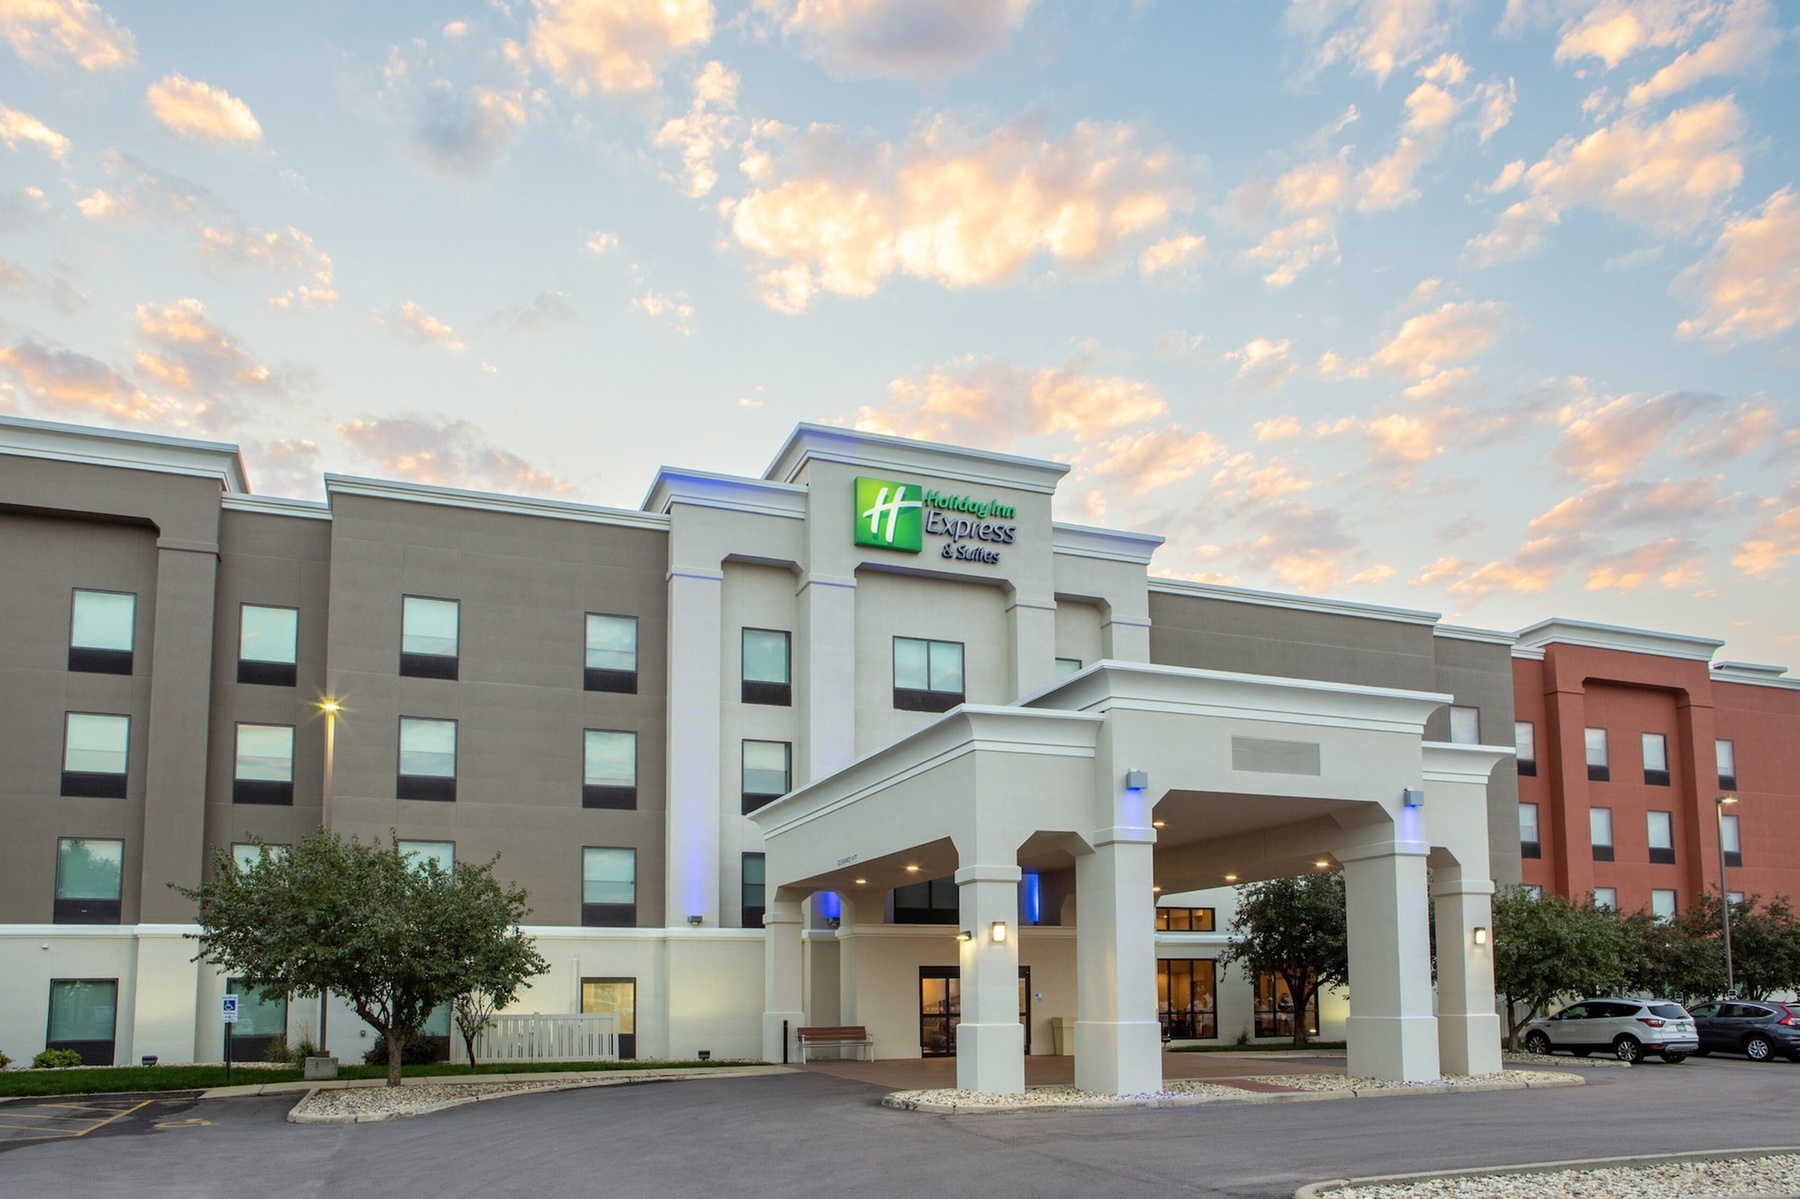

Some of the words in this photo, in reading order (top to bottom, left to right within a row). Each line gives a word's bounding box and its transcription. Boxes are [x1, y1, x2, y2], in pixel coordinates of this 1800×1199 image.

[925, 489, 989, 518] Holiday
[991, 499, 1017, 519] Inn
[926, 510, 1018, 544] Express
[941, 544, 953, 559] &
[955, 544, 1001, 564] Suites
